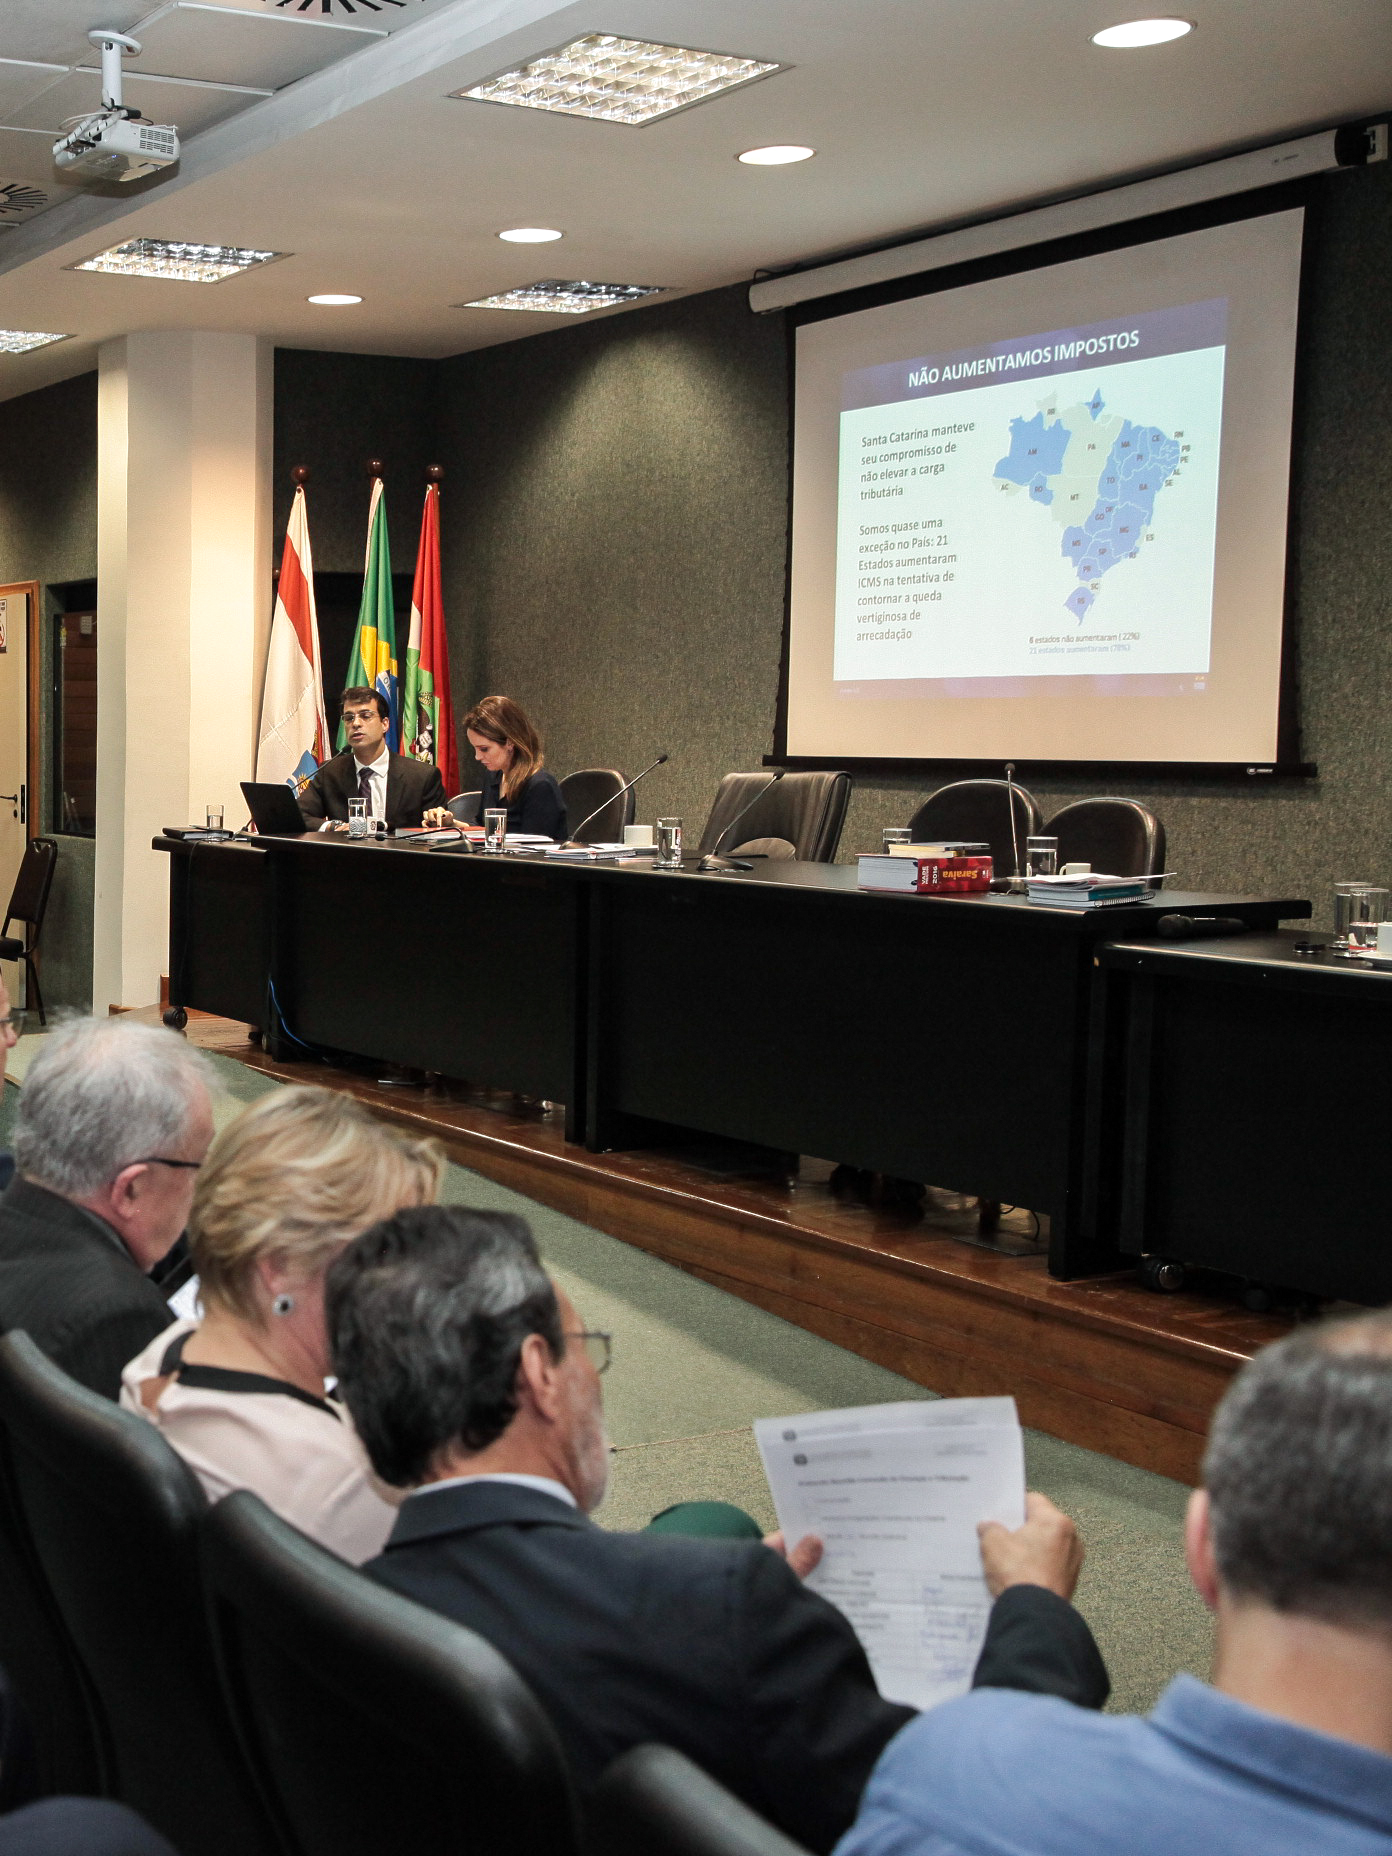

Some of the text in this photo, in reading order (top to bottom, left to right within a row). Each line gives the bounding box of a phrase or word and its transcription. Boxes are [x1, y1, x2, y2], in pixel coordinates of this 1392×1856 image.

[908, 330, 1140, 388] NÃO AUMENTAMOS IMPOSTOS
[861, 422, 975, 448] Santa Catarina manteve
[861, 442, 957, 465] seu compromisso de
[860, 463, 945, 483] não elevar a carga
[860, 486, 903, 500] tributária
[859, 519, 943, 536] Somos quase uma
[859, 535, 948, 554] exceção no País: 21
[858, 554, 957, 570] Estados aumentaram
[858, 571, 954, 588] ICMS na tentativa de
[858, 590, 942, 606] contornar a queda
[857, 610, 921, 624] vertiginosa de
[857, 628, 912, 642] arrecadação
[943, 870, 978, 880] Saraiva
